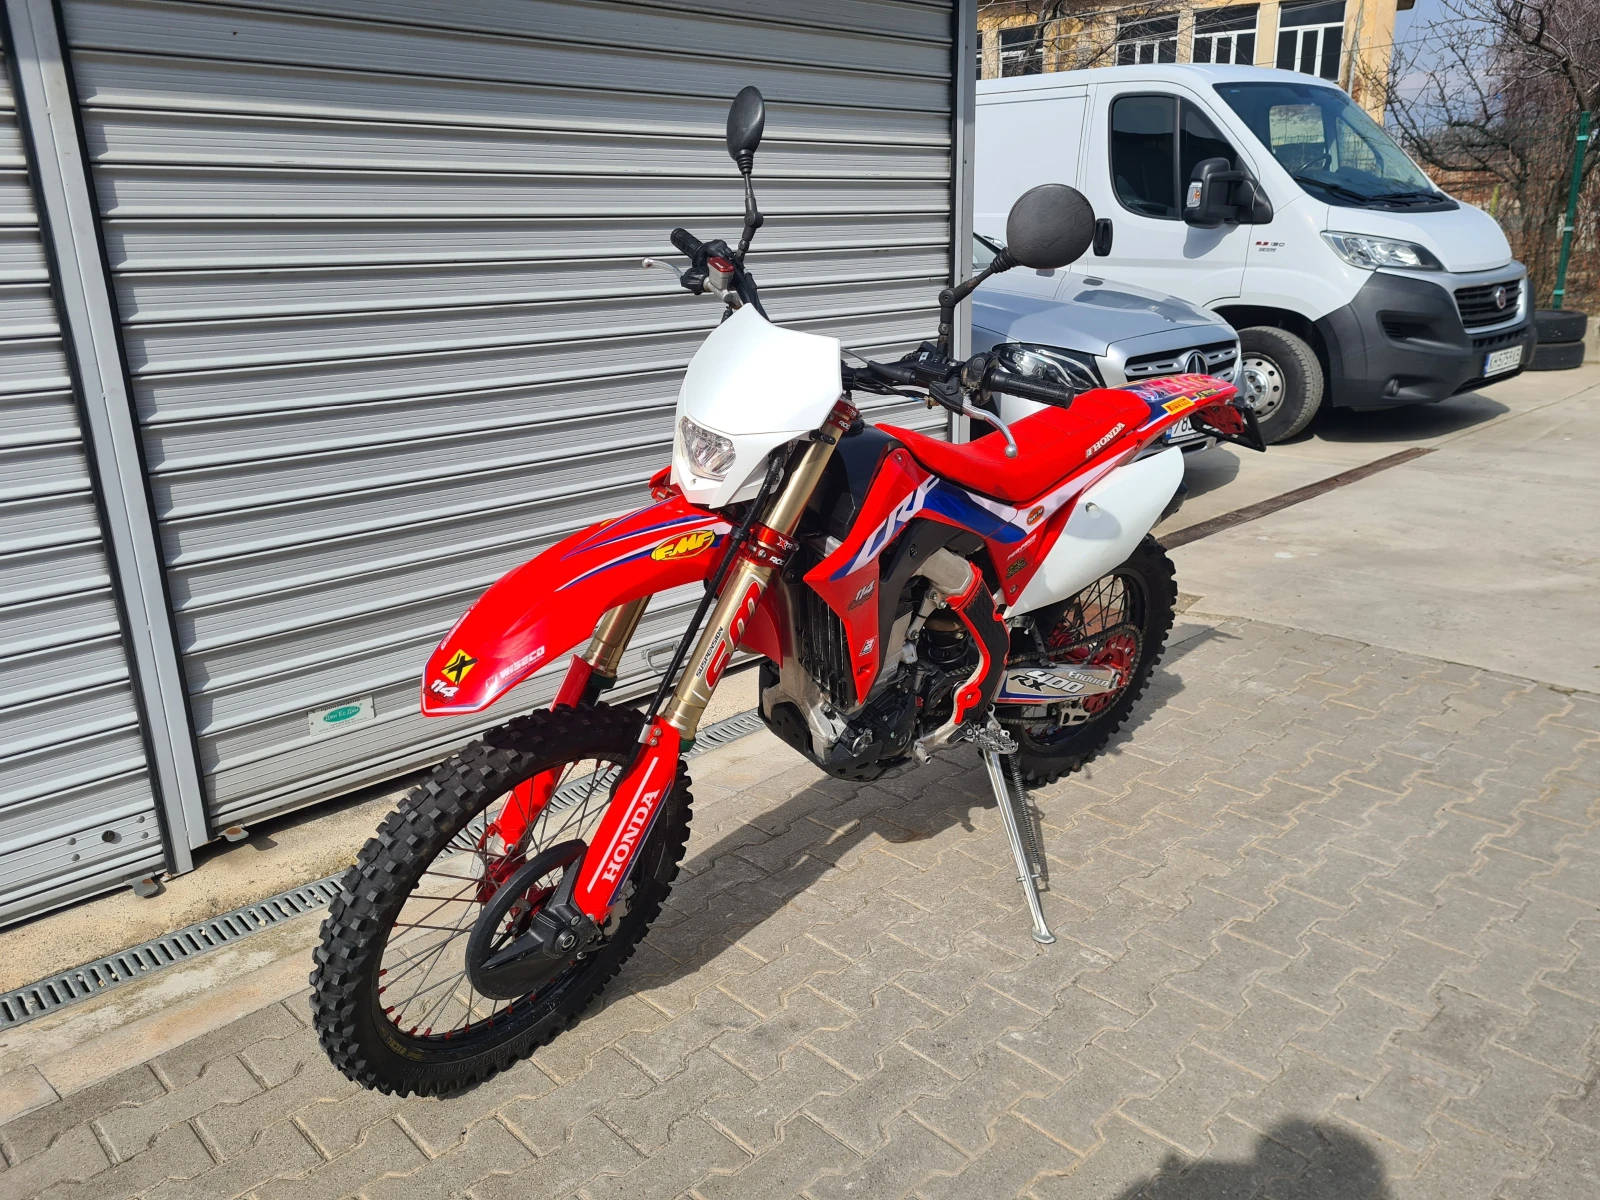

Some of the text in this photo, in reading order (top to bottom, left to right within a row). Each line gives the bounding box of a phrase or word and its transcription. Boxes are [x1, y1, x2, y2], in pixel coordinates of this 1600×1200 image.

[1093, 422, 1126, 453] HONDA
[655, 530, 716, 561] FMF
[695, 626, 724, 679] SUSPENSION
[430, 679, 460, 698] 114
[1025, 670, 1085, 694] 400
[1068, 671, 1111, 687] Enduro
[601, 789, 661, 884] HONDA
